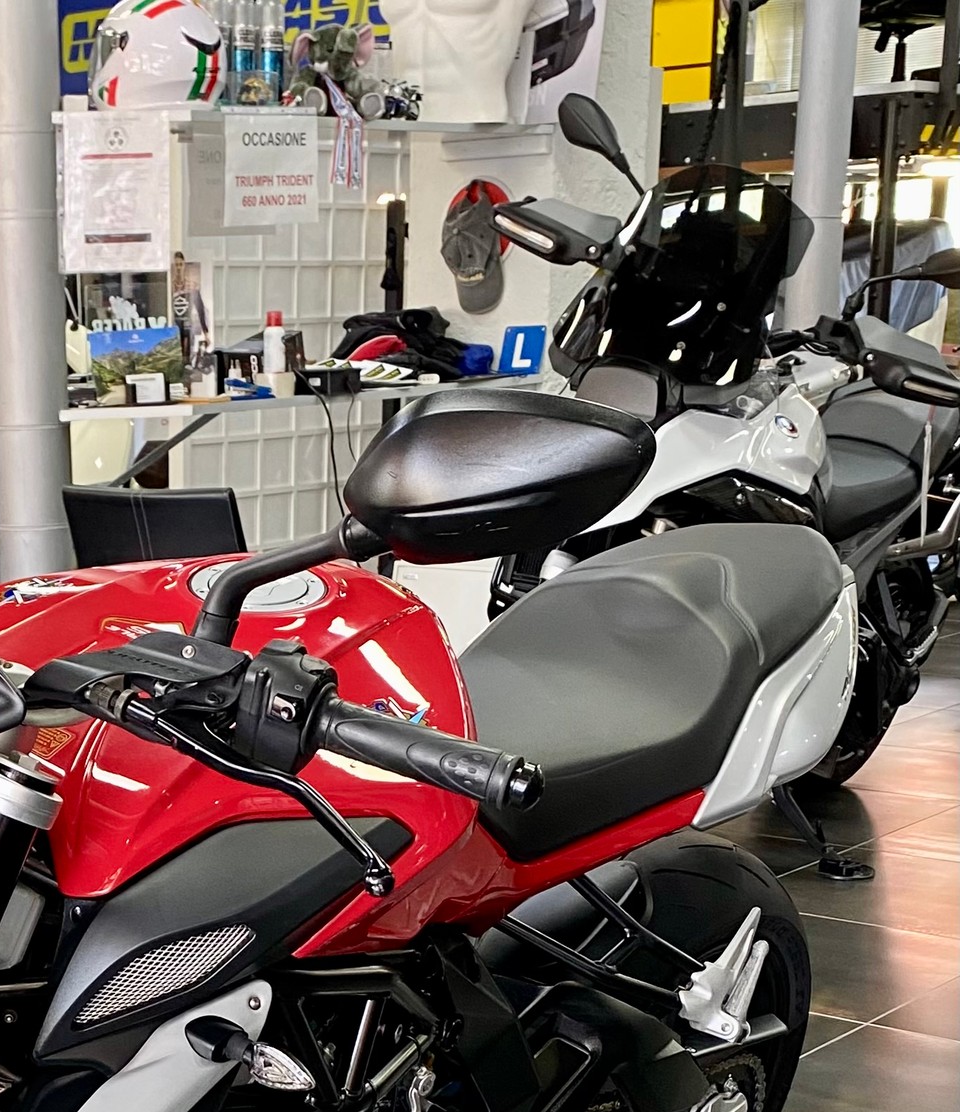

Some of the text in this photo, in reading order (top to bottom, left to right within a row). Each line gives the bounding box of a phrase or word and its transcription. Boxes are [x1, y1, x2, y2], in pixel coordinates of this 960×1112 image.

[242, 132, 307, 147] OCCASIONE
[235, 174, 314, 188] TRIUMPH TRIDENT
[242, 194, 307, 207] 660 ANNO 2021
[511, 332, 531, 368] L
